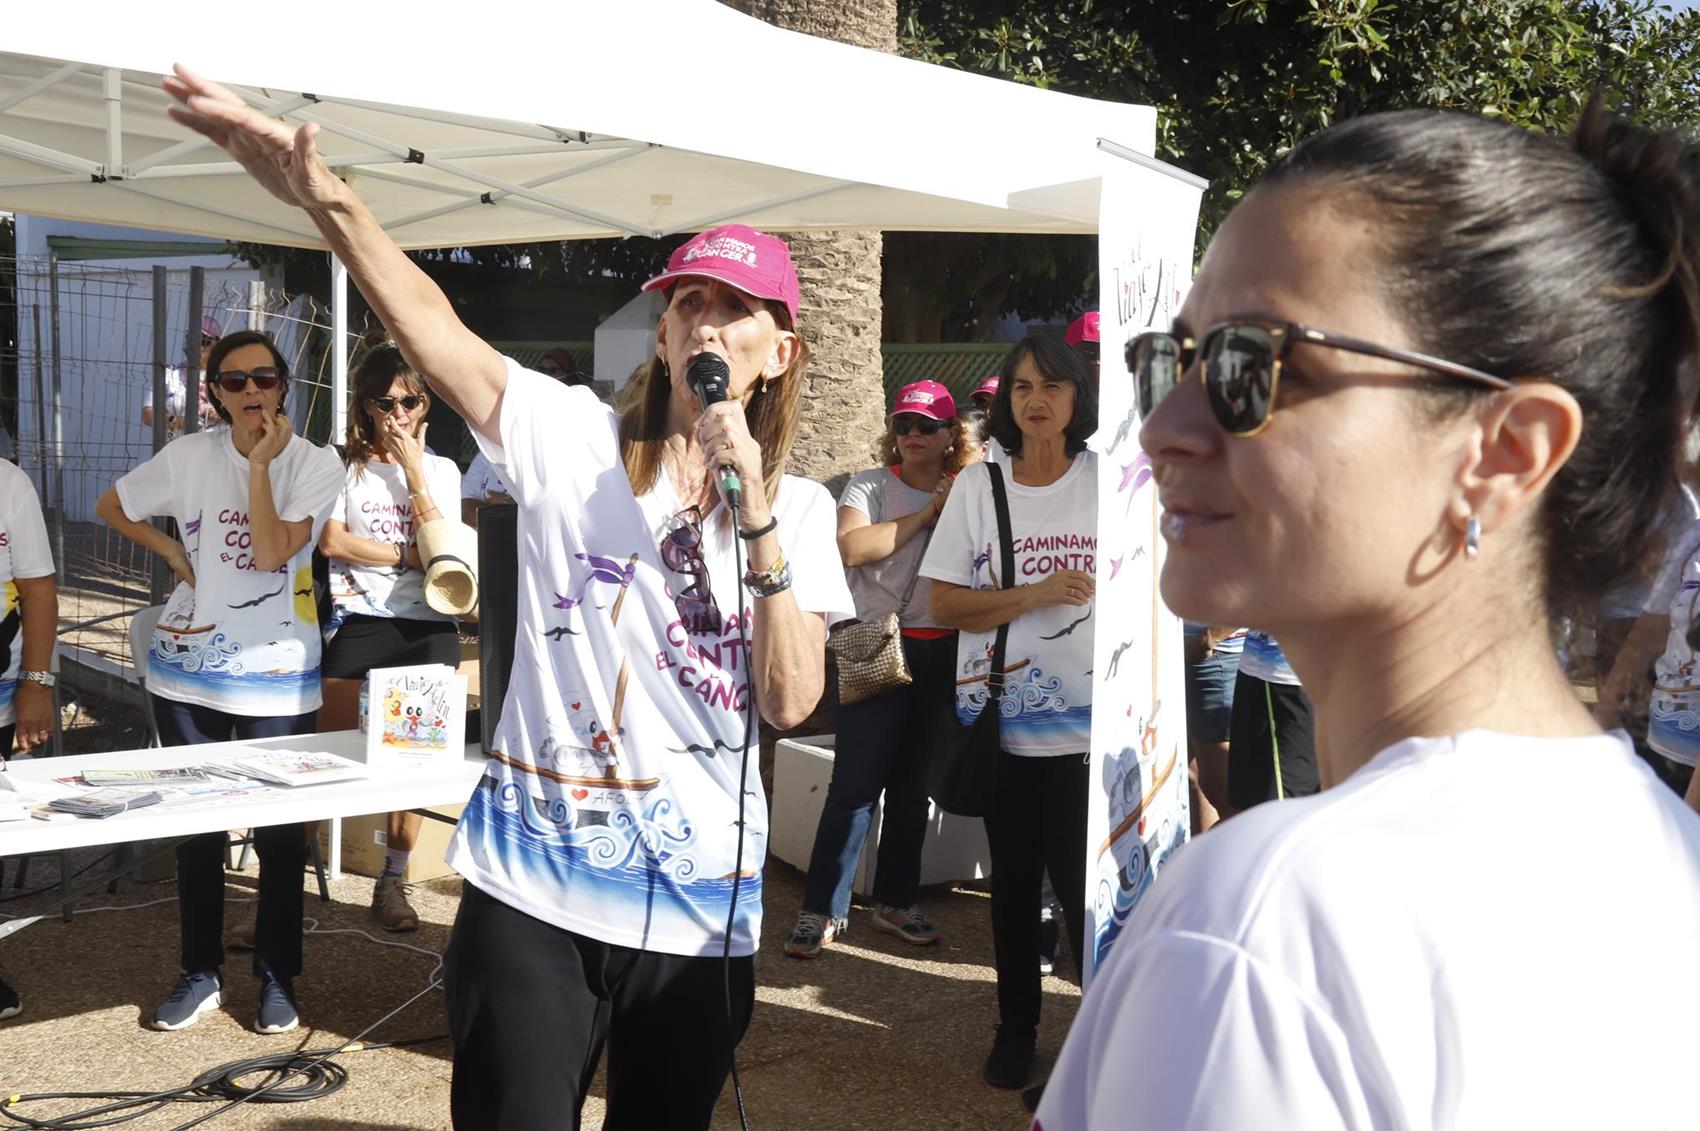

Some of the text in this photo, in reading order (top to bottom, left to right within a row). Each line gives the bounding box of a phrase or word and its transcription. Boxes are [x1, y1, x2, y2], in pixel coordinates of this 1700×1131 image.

[1011, 534, 1097, 553] CAMINAM
[220, 552, 234, 563] EL
[1022, 553, 1096, 576] CONTR
[656, 651, 677, 671] EL
